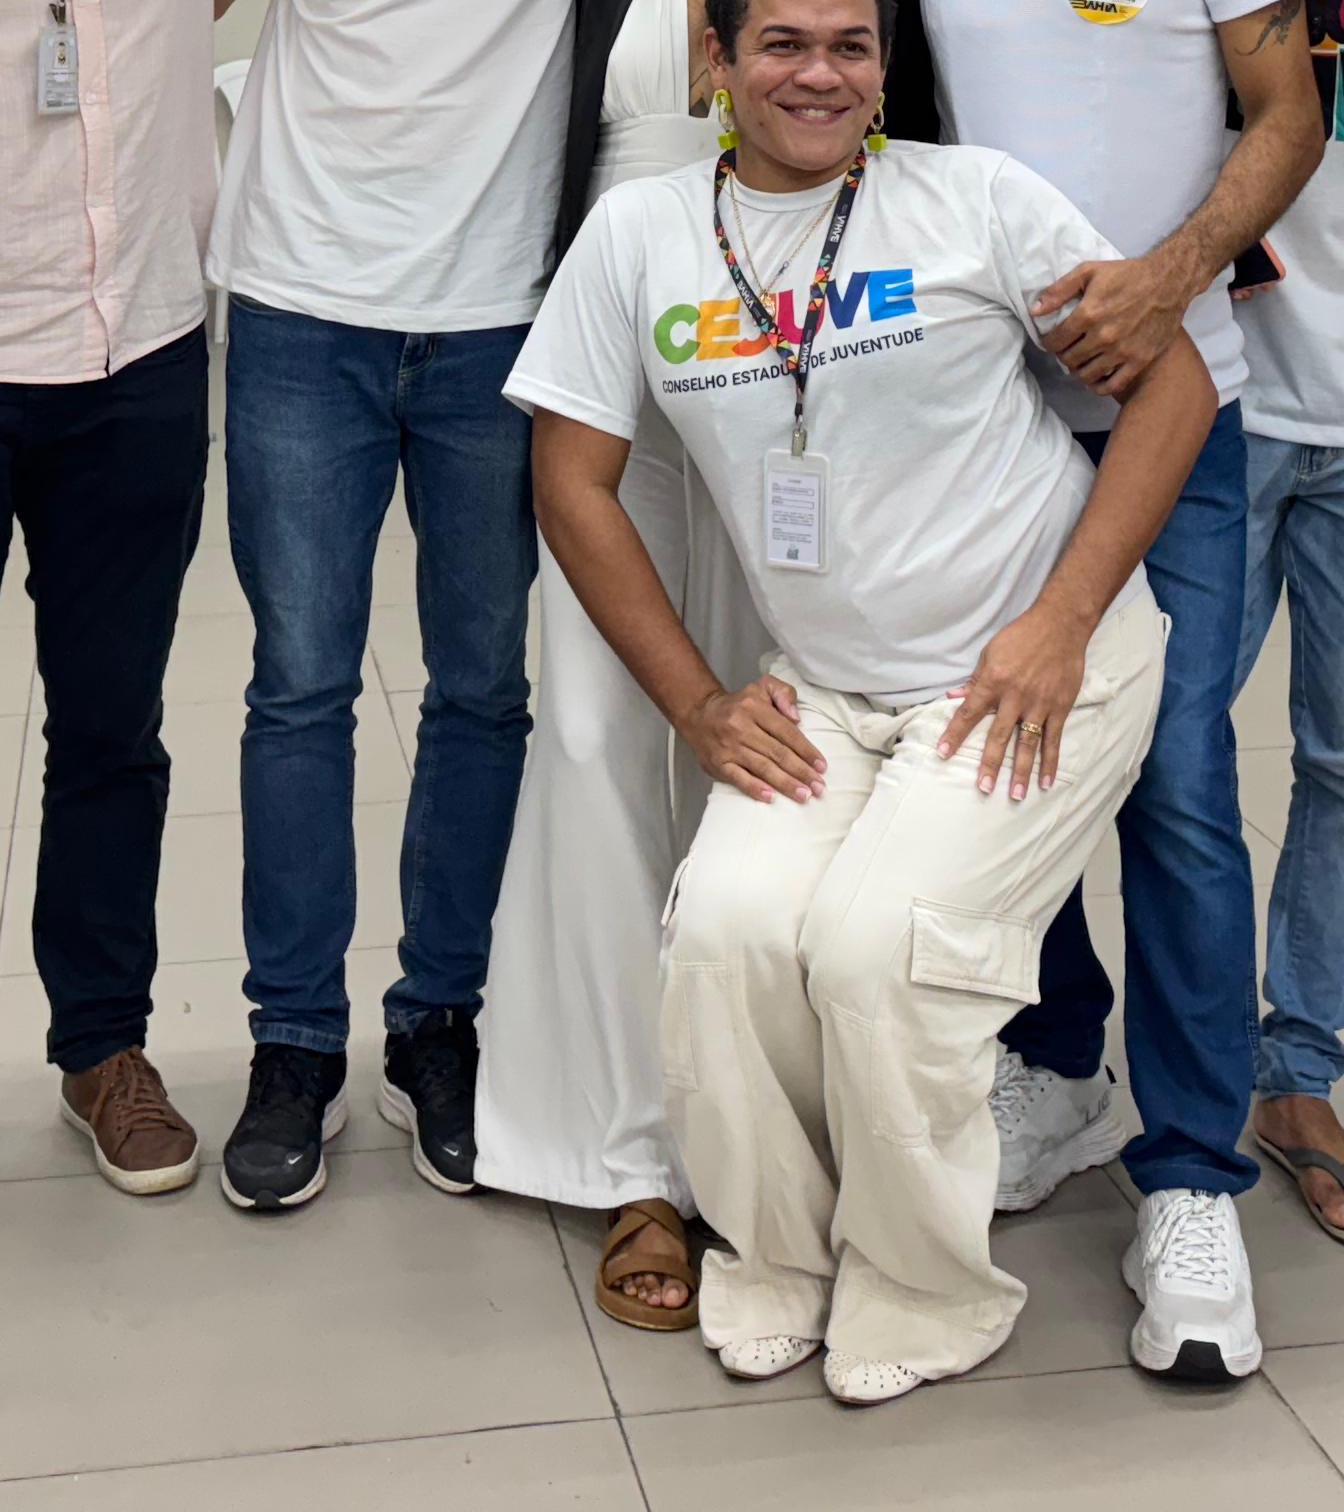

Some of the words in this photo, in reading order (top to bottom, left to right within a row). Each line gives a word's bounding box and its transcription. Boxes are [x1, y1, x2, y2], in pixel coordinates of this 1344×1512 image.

[662, 374, 727, 394] CONSELHO
[732, 363, 792, 386] ESTADU
[811, 351, 827, 369] DE
[829, 327, 925, 363] JUVENTUDE
